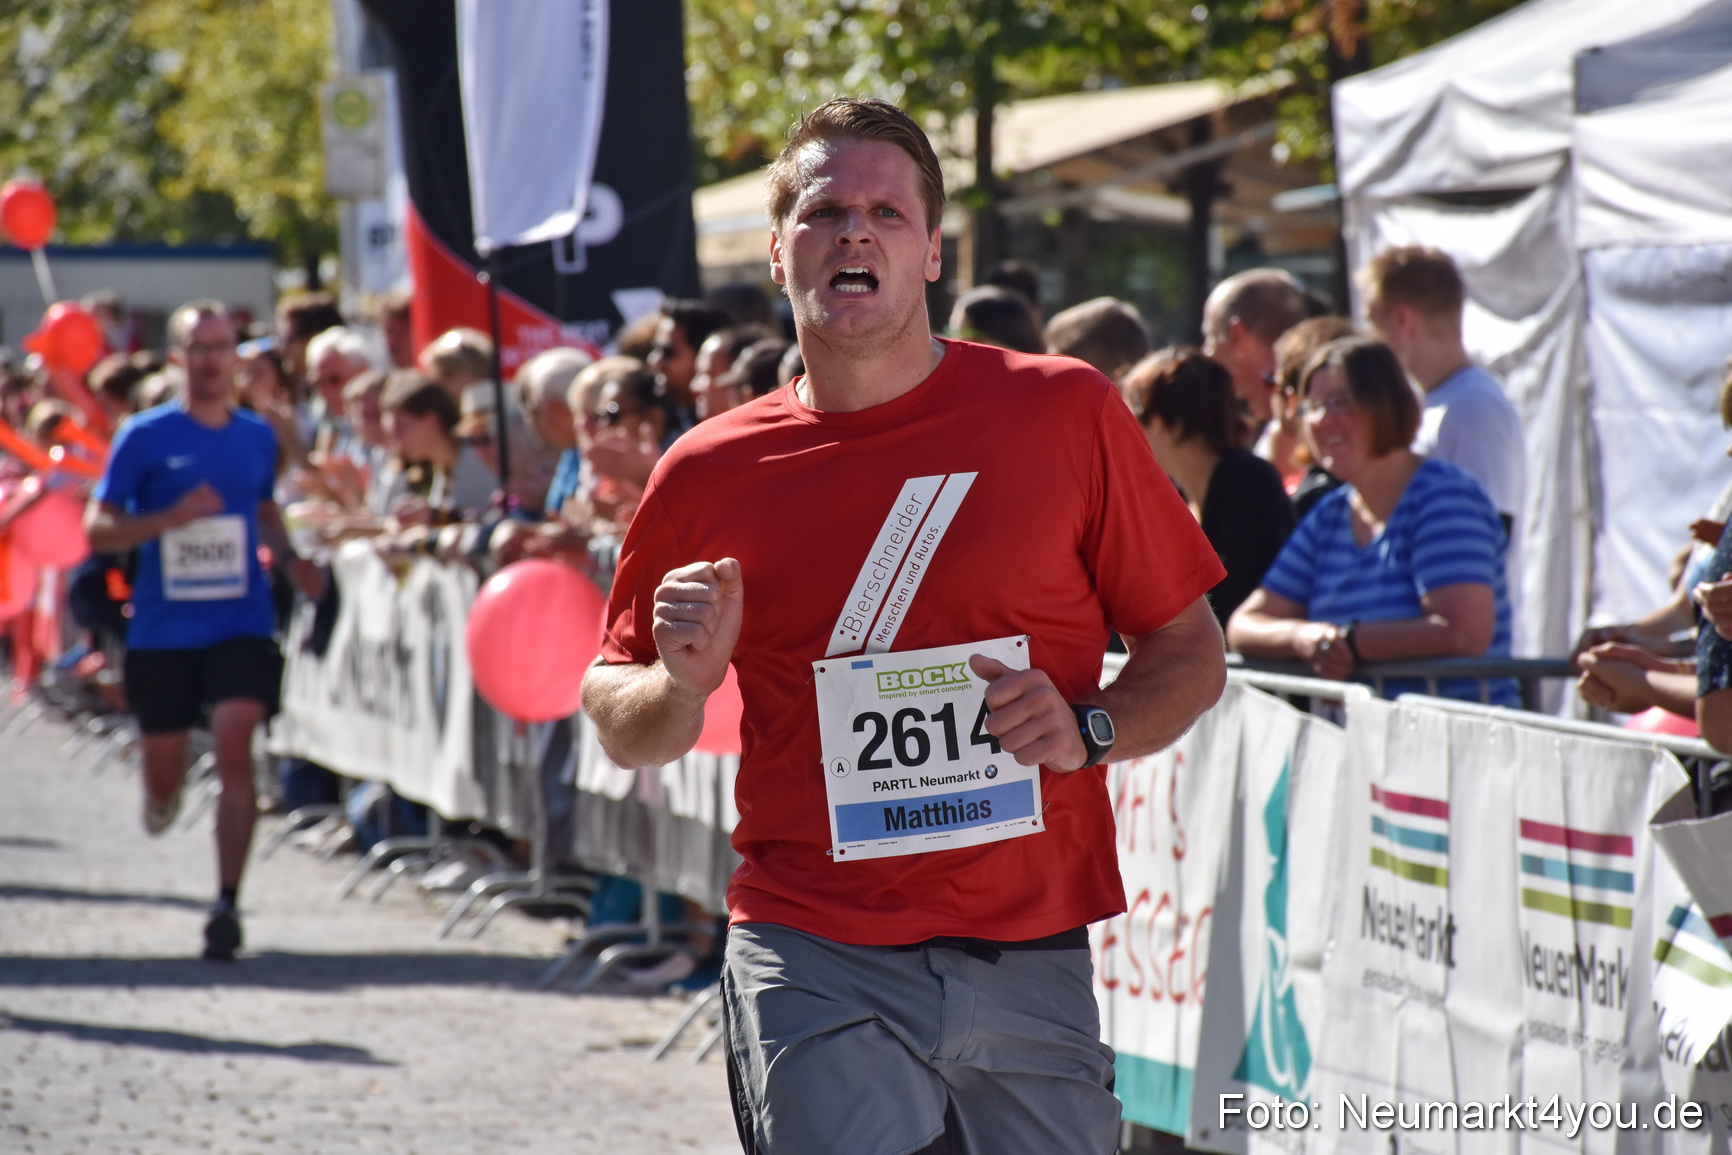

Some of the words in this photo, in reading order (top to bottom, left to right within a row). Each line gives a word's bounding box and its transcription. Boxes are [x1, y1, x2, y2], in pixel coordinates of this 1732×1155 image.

[842, 493, 922, 634] Bierschneider
[876, 588, 910, 643] Menschen
[905, 561, 920, 585] und
[914, 525, 941, 561] Autos.
[876, 661, 971, 692] BOCK
[879, 691, 907, 700] inspired
[919, 688, 940, 696] smart
[941, 683, 972, 692] concepts
[836, 763, 845, 774] A
[872, 778, 917, 792] PARTL
[919, 769, 981, 787] Neumarkt
[883, 798, 992, 832] Matthias
